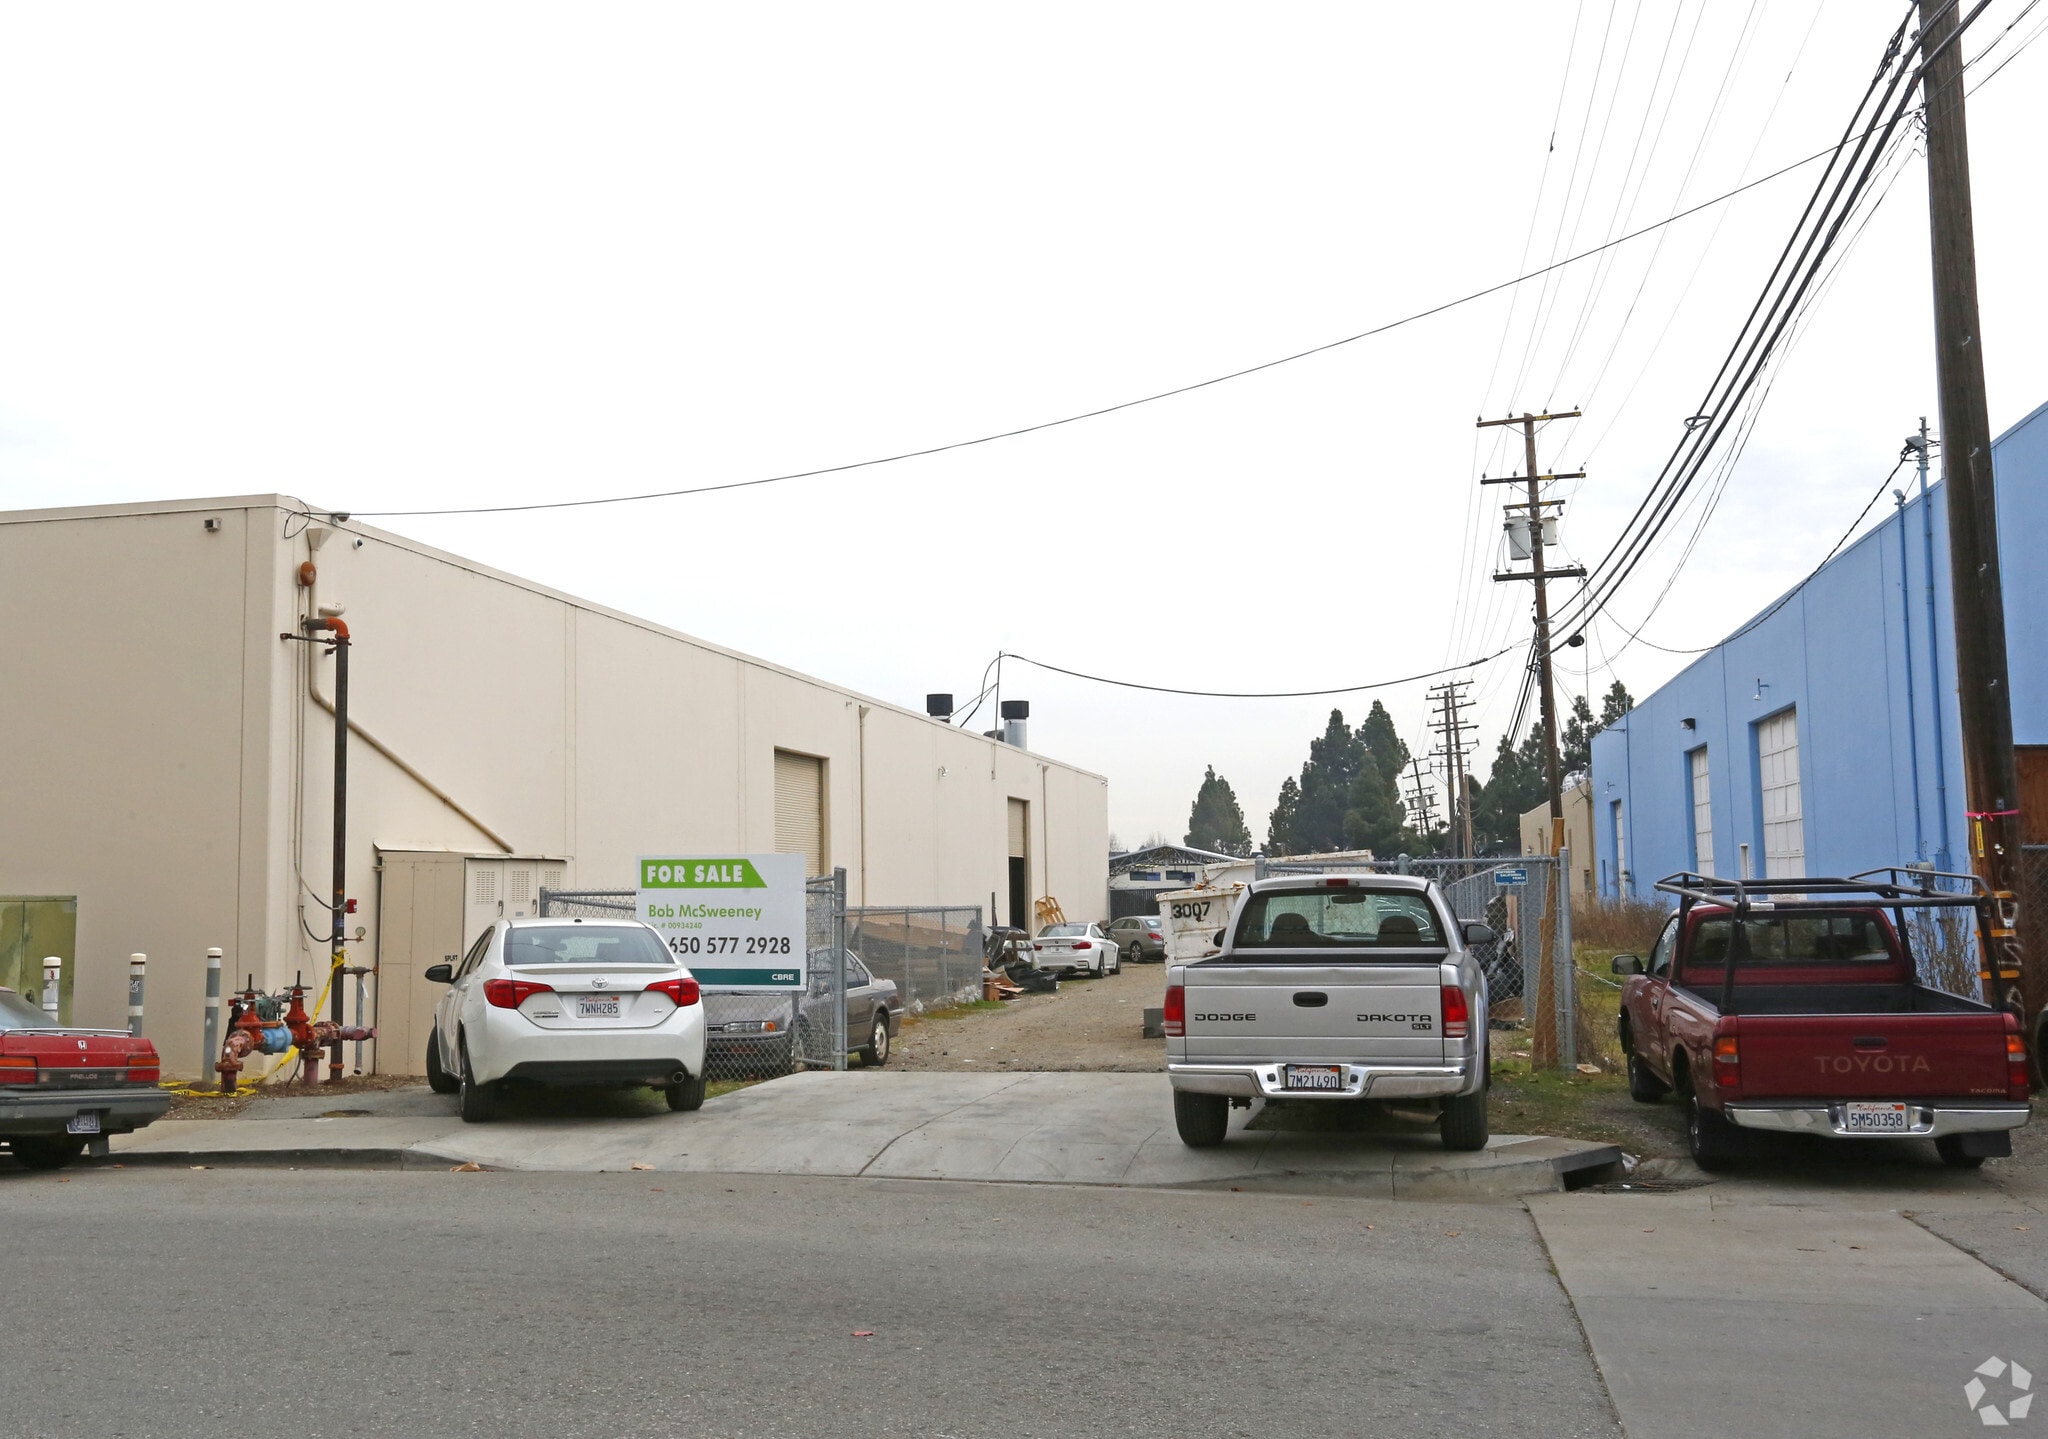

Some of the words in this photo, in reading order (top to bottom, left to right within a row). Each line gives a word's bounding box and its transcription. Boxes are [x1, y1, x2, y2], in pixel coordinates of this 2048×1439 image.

[647, 865, 686, 883] FOR
[694, 864, 743, 883] SALE
[648, 904, 675, 918] Bob
[679, 904, 762, 921] McSweeney
[1172, 901, 1211, 919] 3007
[669, 937, 701, 954] 650
[706, 937, 740, 954] 577
[746, 937, 791, 954] 2928
[771, 973, 795, 981] CBRE
[580, 1003, 619, 1014] 7WNH285
[1194, 1013, 1257, 1021] DODGE
[1356, 1014, 1432, 1022] DAKOTA
[1813, 1055, 1931, 1073] TOYOTA
[1289, 1075, 1337, 1089] 7M21490
[1850, 1112, 1904, 1127] 5M50358
